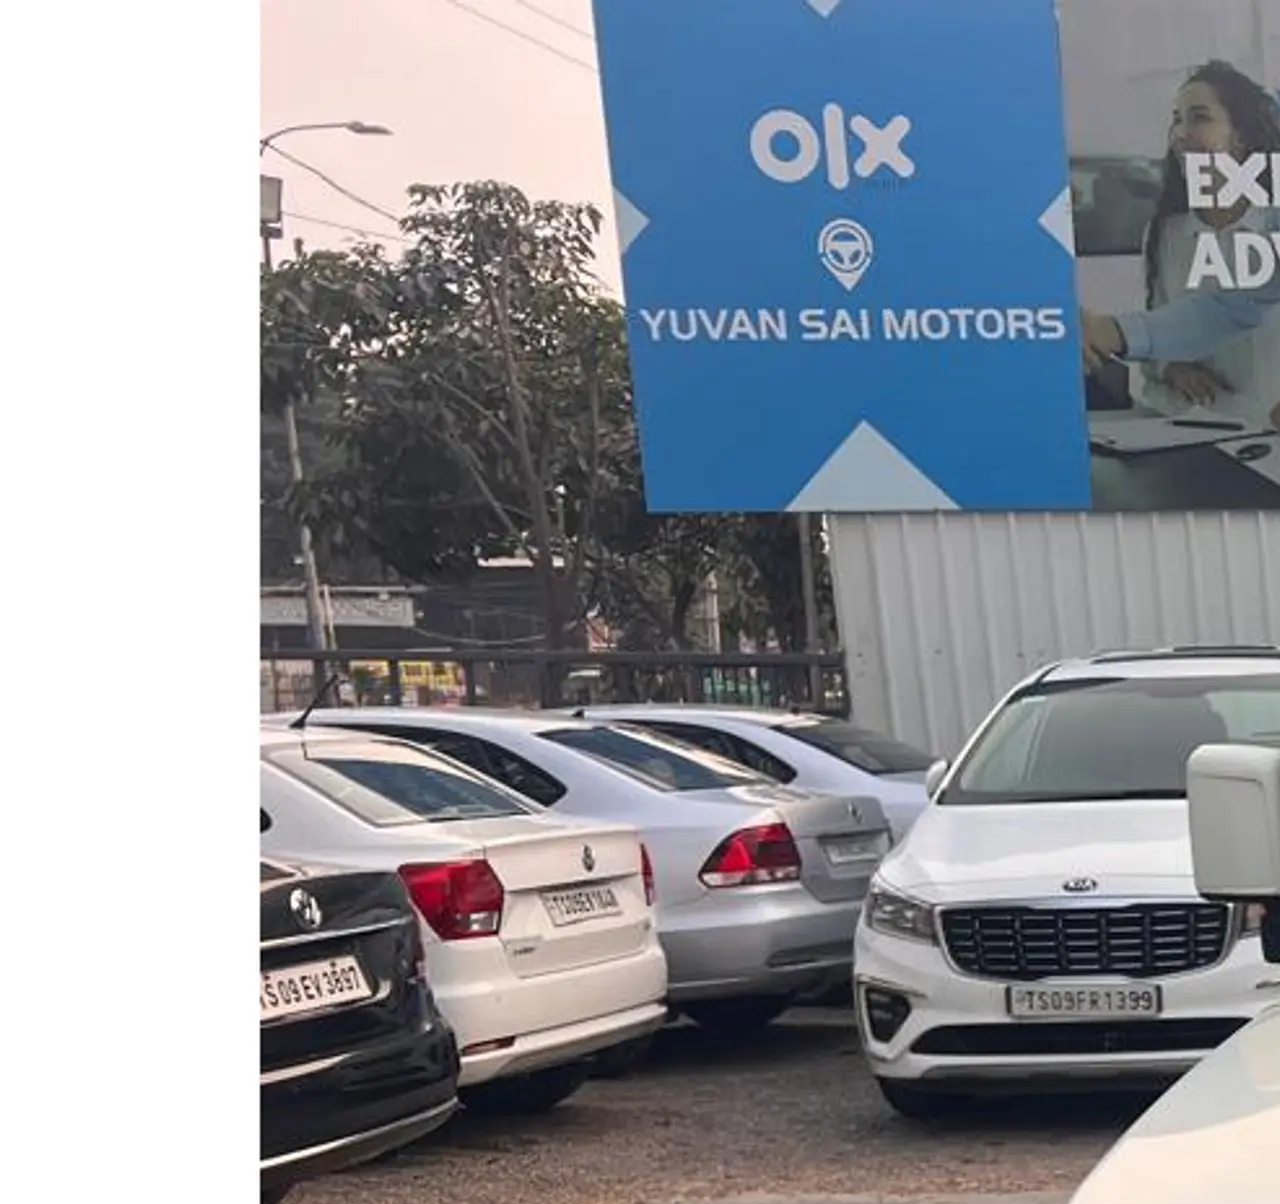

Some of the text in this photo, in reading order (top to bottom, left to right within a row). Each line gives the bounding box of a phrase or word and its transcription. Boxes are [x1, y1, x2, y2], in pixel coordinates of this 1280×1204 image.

[640, 308, 1066, 341] YUVAN SAI MOTORS
